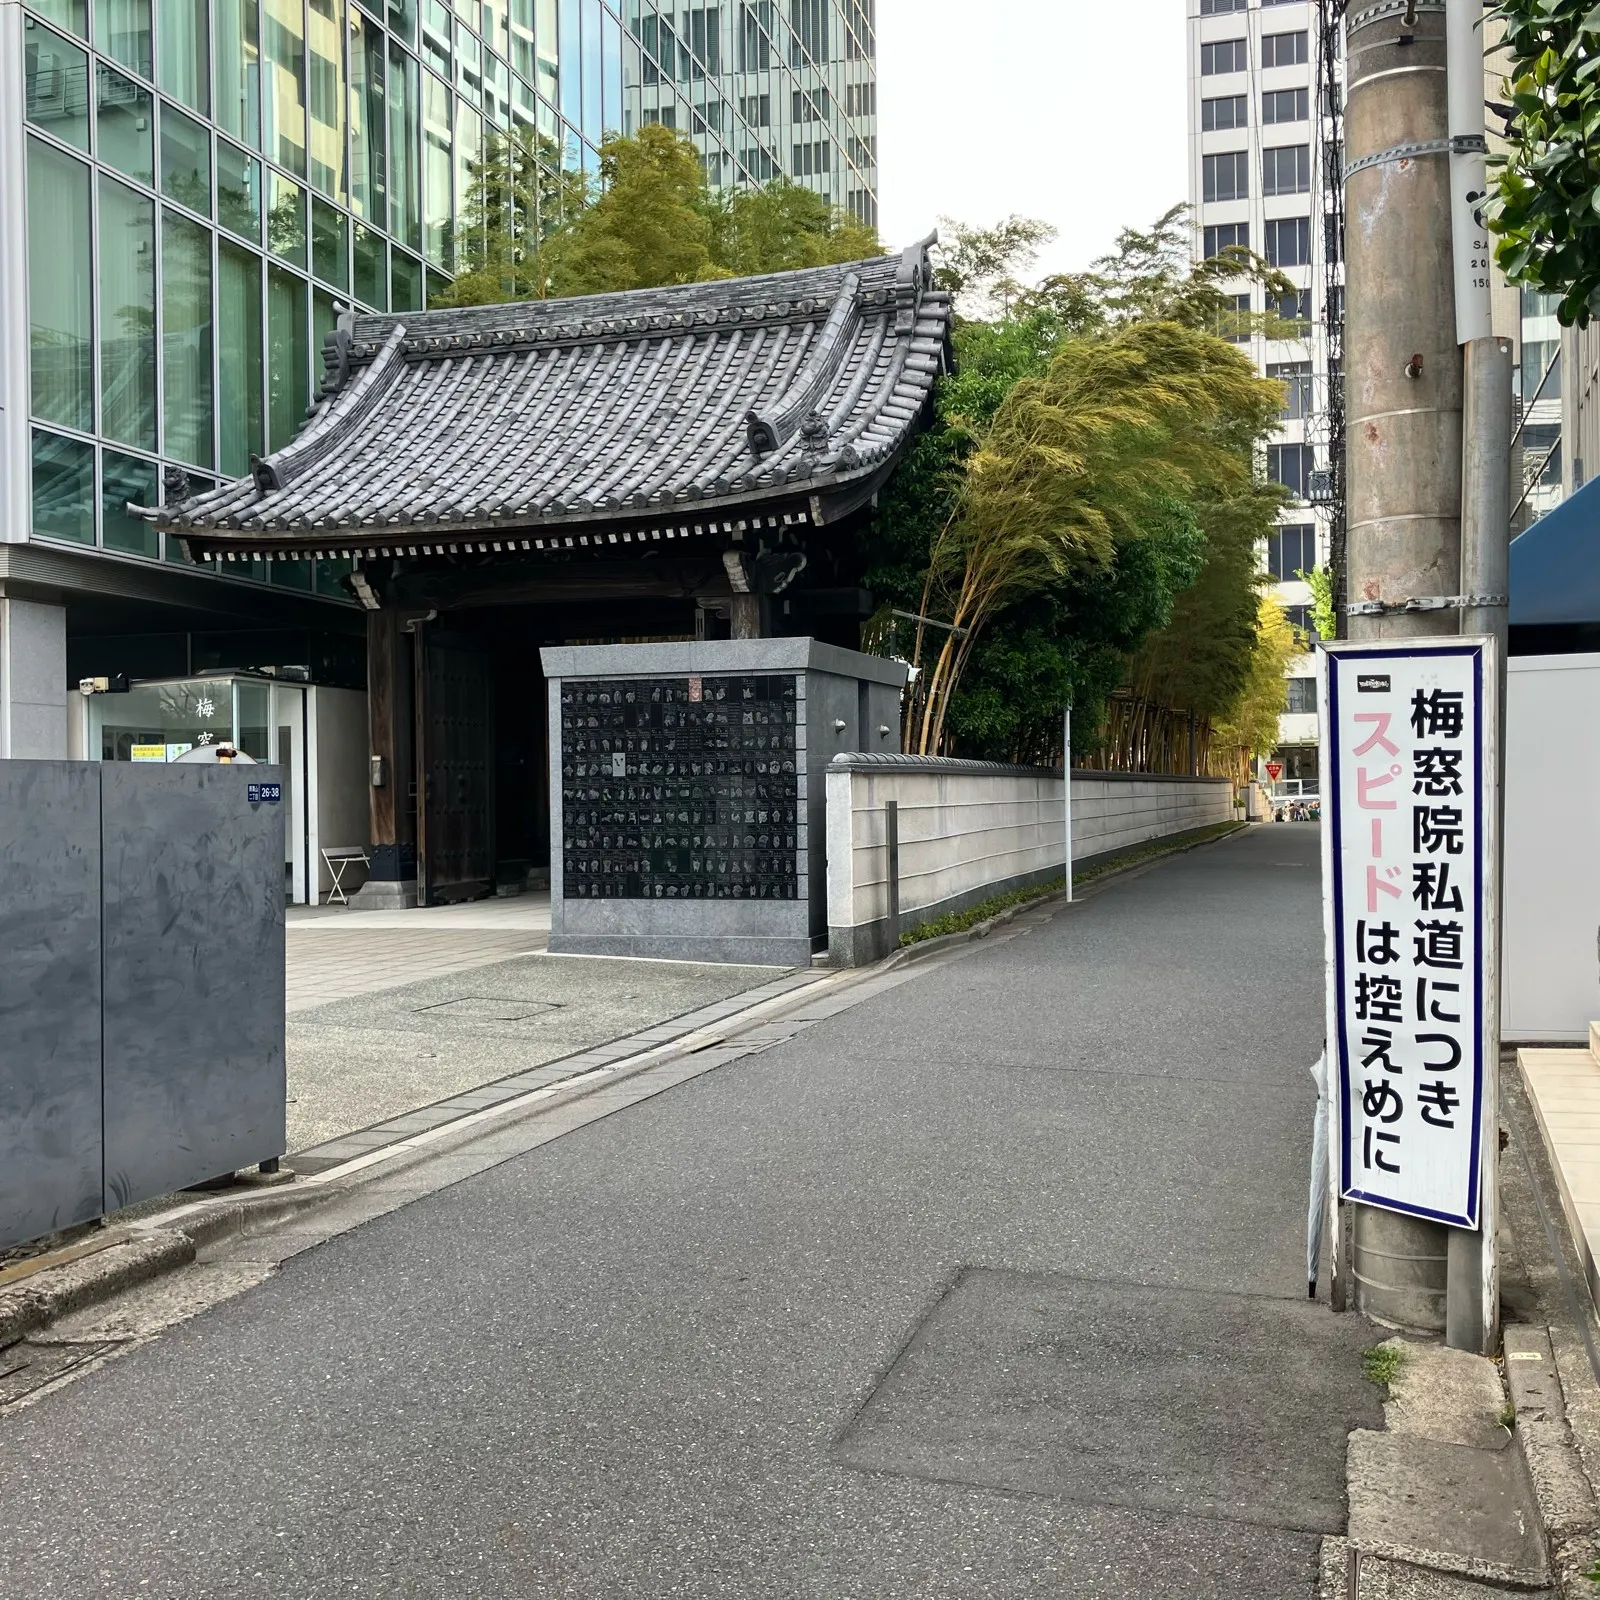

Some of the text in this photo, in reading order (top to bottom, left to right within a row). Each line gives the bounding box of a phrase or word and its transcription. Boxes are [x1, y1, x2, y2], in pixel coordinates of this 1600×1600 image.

[261, 787, 280, 798] 26-38
[1352, 712, 1404, 1174] スピードは控えめに
[1410, 688, 1464, 1129] 梅窓院私道につき
